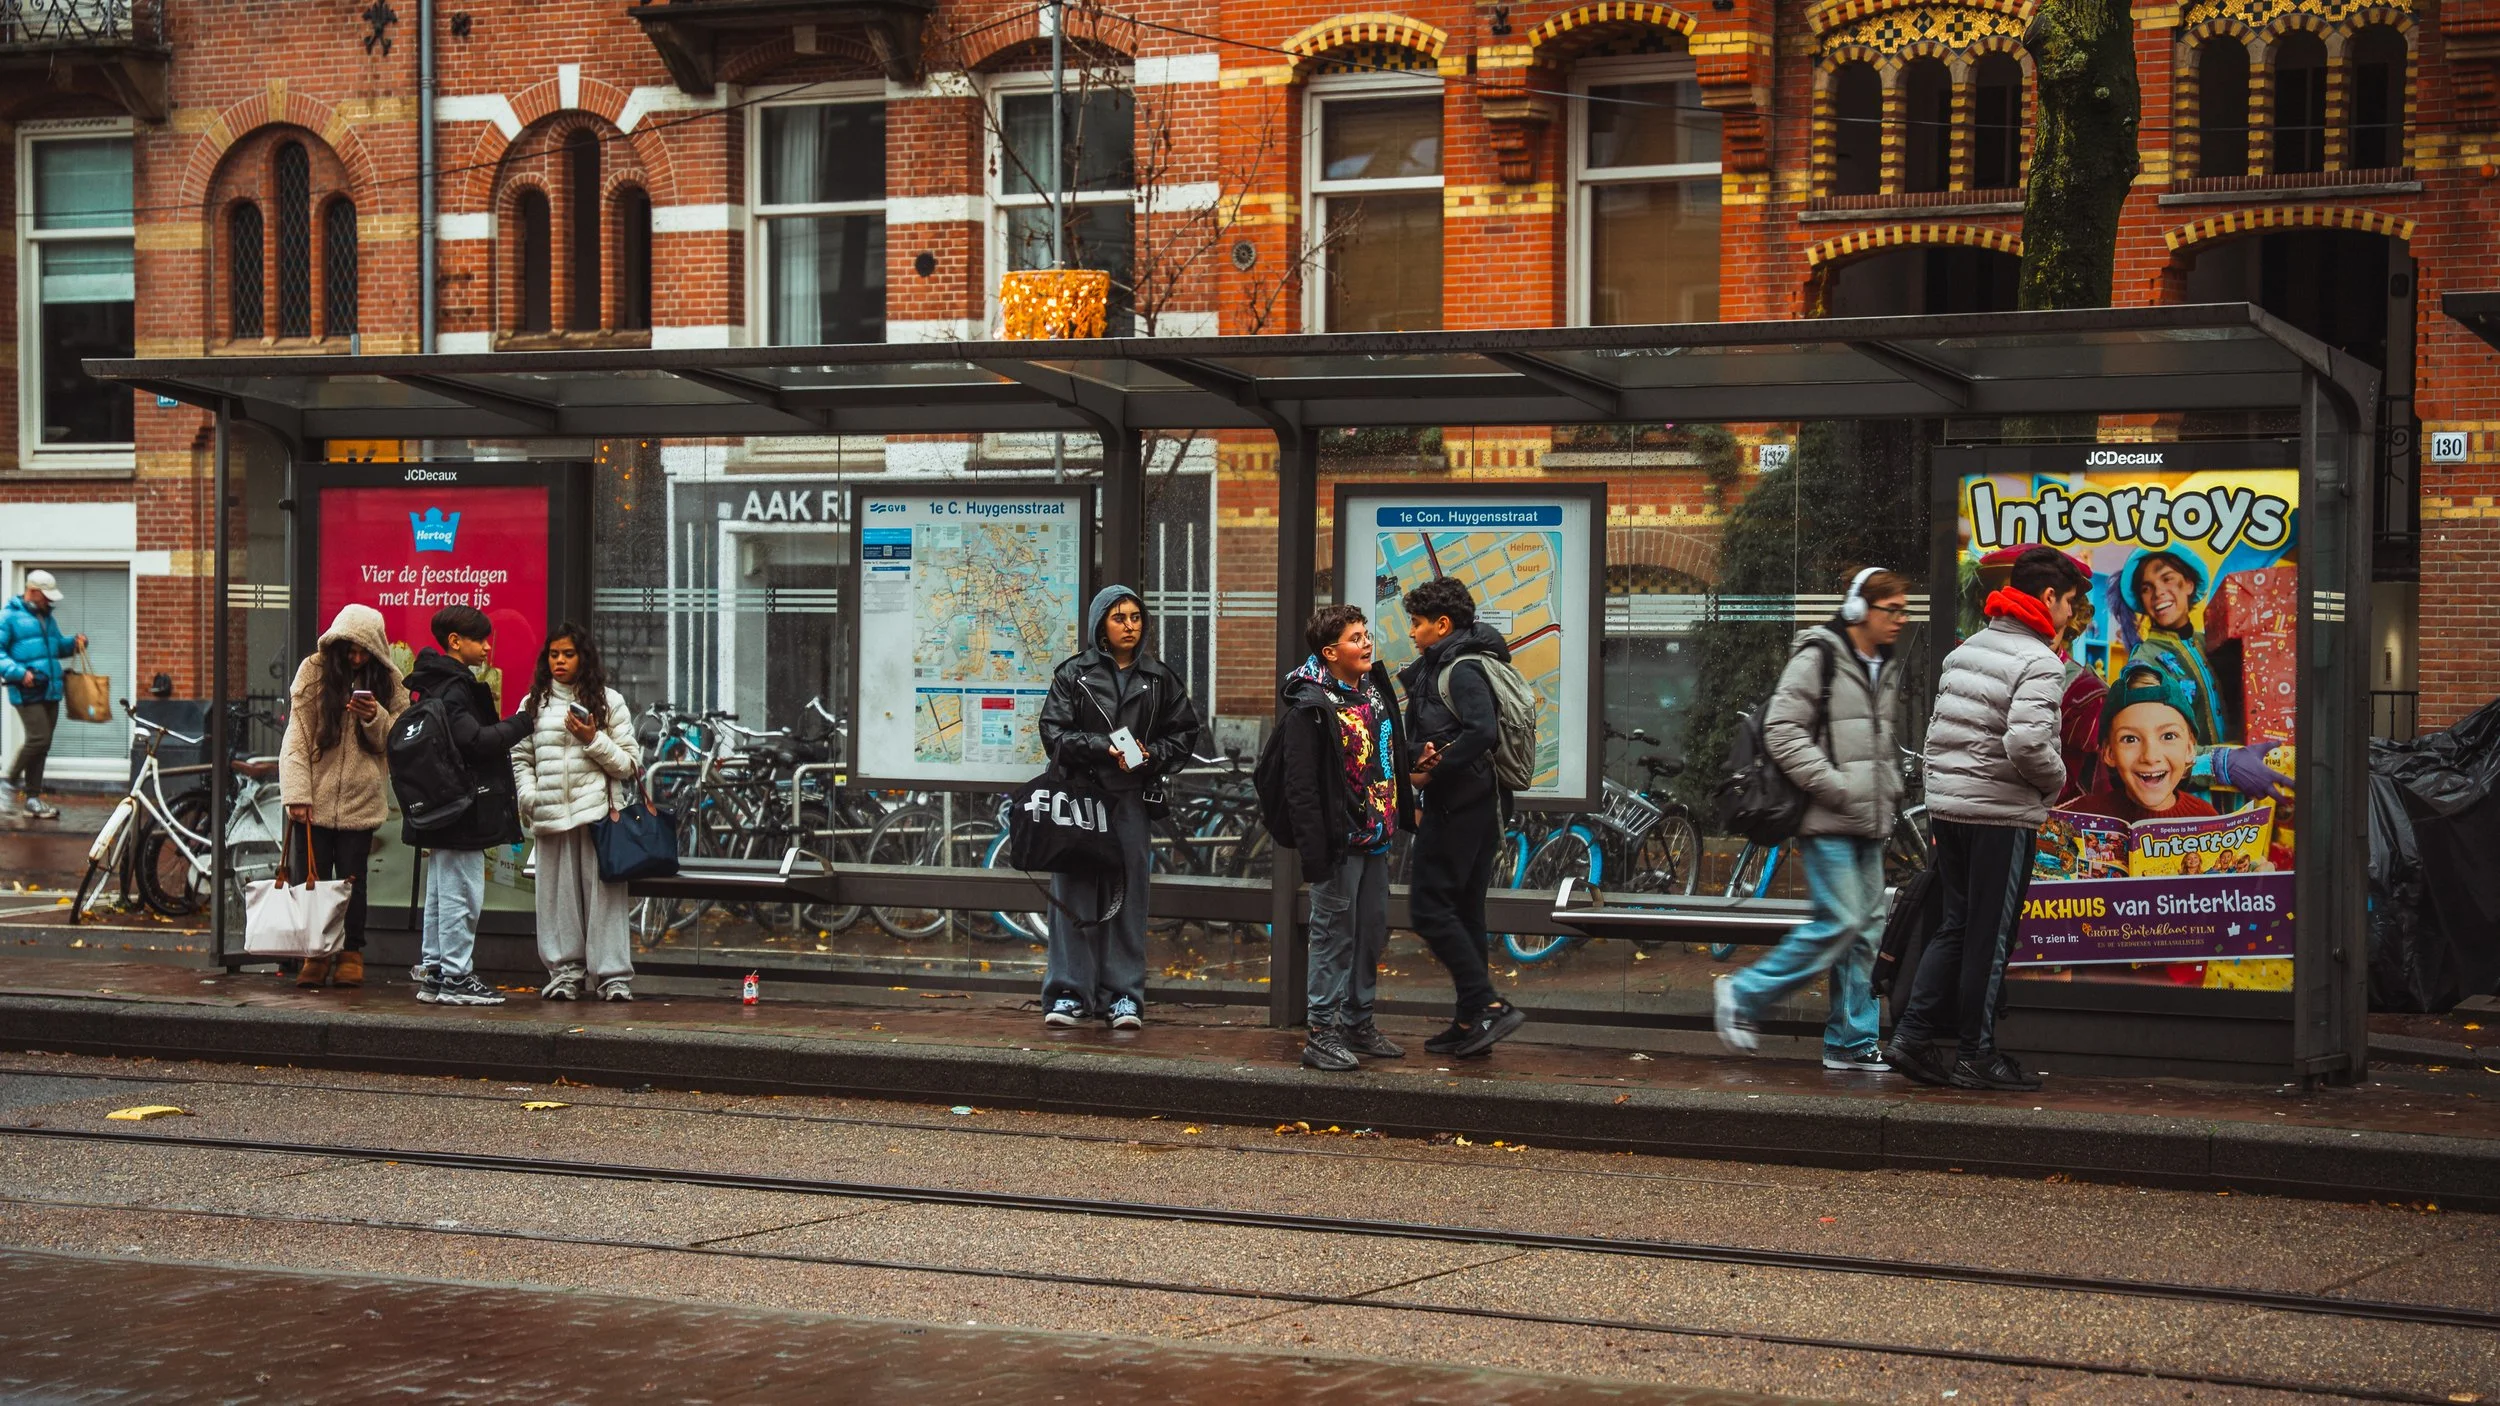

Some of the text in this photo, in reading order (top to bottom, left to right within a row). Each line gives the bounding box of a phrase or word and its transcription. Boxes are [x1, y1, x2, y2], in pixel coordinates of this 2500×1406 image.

[2436, 438, 2462, 456] 130
[1763, 450, 1785, 467] 132
[2086, 451, 2163, 465] JCDecaux
[404, 469, 457, 481] JCDecaux
[741, 490, 812, 521] AAK
[887, 504, 906, 512] GVB
[929, 501, 1065, 517] 1e C. Huygensstraat
[1400, 511, 1538, 525] 1e Con. Huygensstraat
[1970, 481, 2289, 555] Intertoys
[416, 530, 452, 544] Hertog
[361, 565, 507, 587] Vier de feestdagen
[1516, 564, 1540, 572] buurt
[379, 588, 490, 610] met Hertog ijs
[2160, 826, 2179, 834] Spelen
[2141, 825, 2260, 858] Intertoys
[2019, 889, 2277, 920] PAKHUIS van Sinterklaas
[2030, 933, 2079, 944] Te zien in:
[2086, 922, 2215, 940] GROTE Sinterklaas FILM
